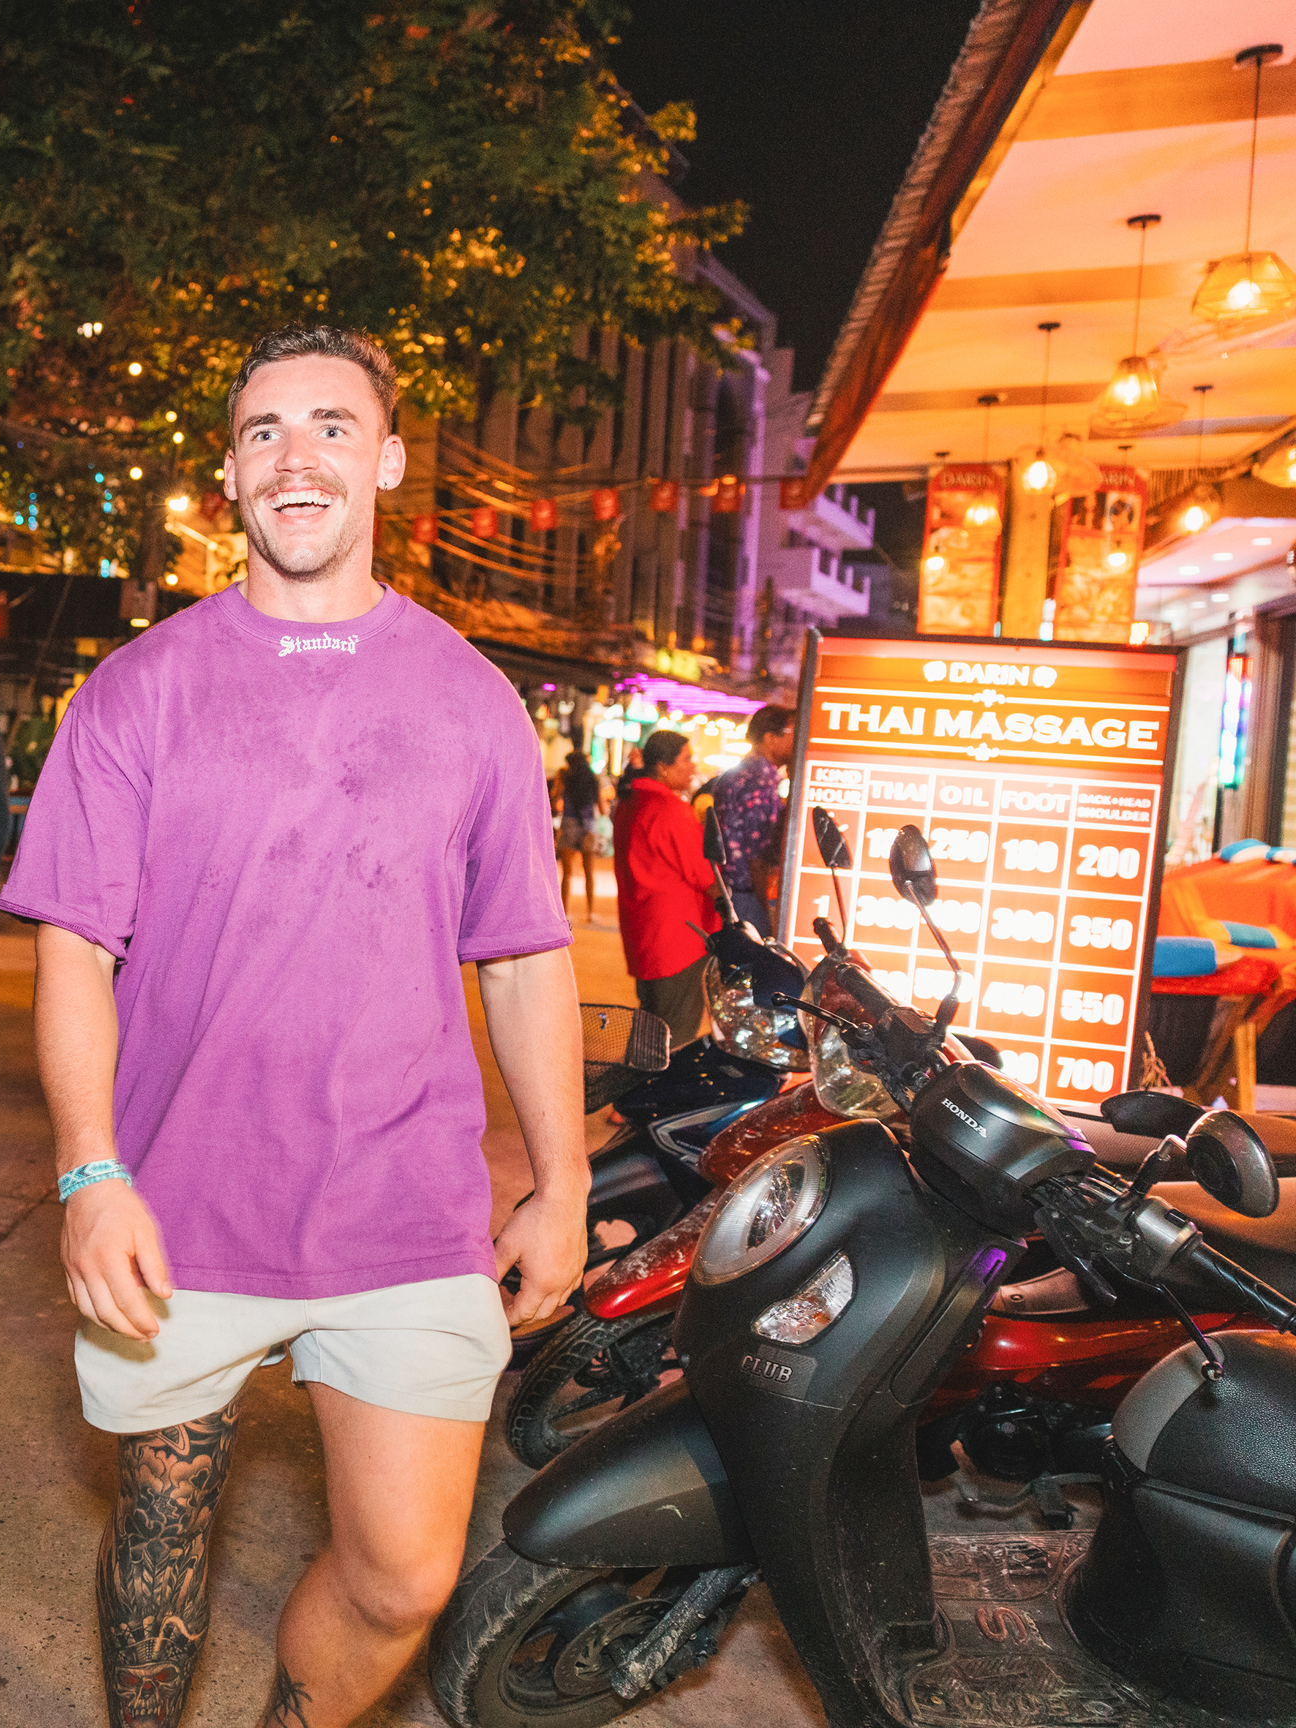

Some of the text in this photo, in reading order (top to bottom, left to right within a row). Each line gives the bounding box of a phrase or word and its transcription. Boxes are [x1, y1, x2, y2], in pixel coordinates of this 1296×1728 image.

[278, 631, 359, 657] Standard
[949, 662, 1030, 686] DARIN
[821, 701, 1160, 751] THAI MASSAGE
[816, 768, 862, 784] KIND
[809, 787, 862, 805] HOUR
[869, 780, 928, 802] THAI
[939, 785, 990, 807] OIL
[1001, 790, 1071, 813] FOOT
[1077, 806, 1150, 822] SHOULDER
[1076, 844, 1140, 880] 200
[1069, 915, 1133, 951] 350
[982, 981, 1045, 1017] 450
[1060, 989, 1124, 1025] 550
[1057, 1056, 1114, 1092] 700
[941, 1097, 987, 1138] HONDA
[741, 1354, 793, 1383] CLUB
